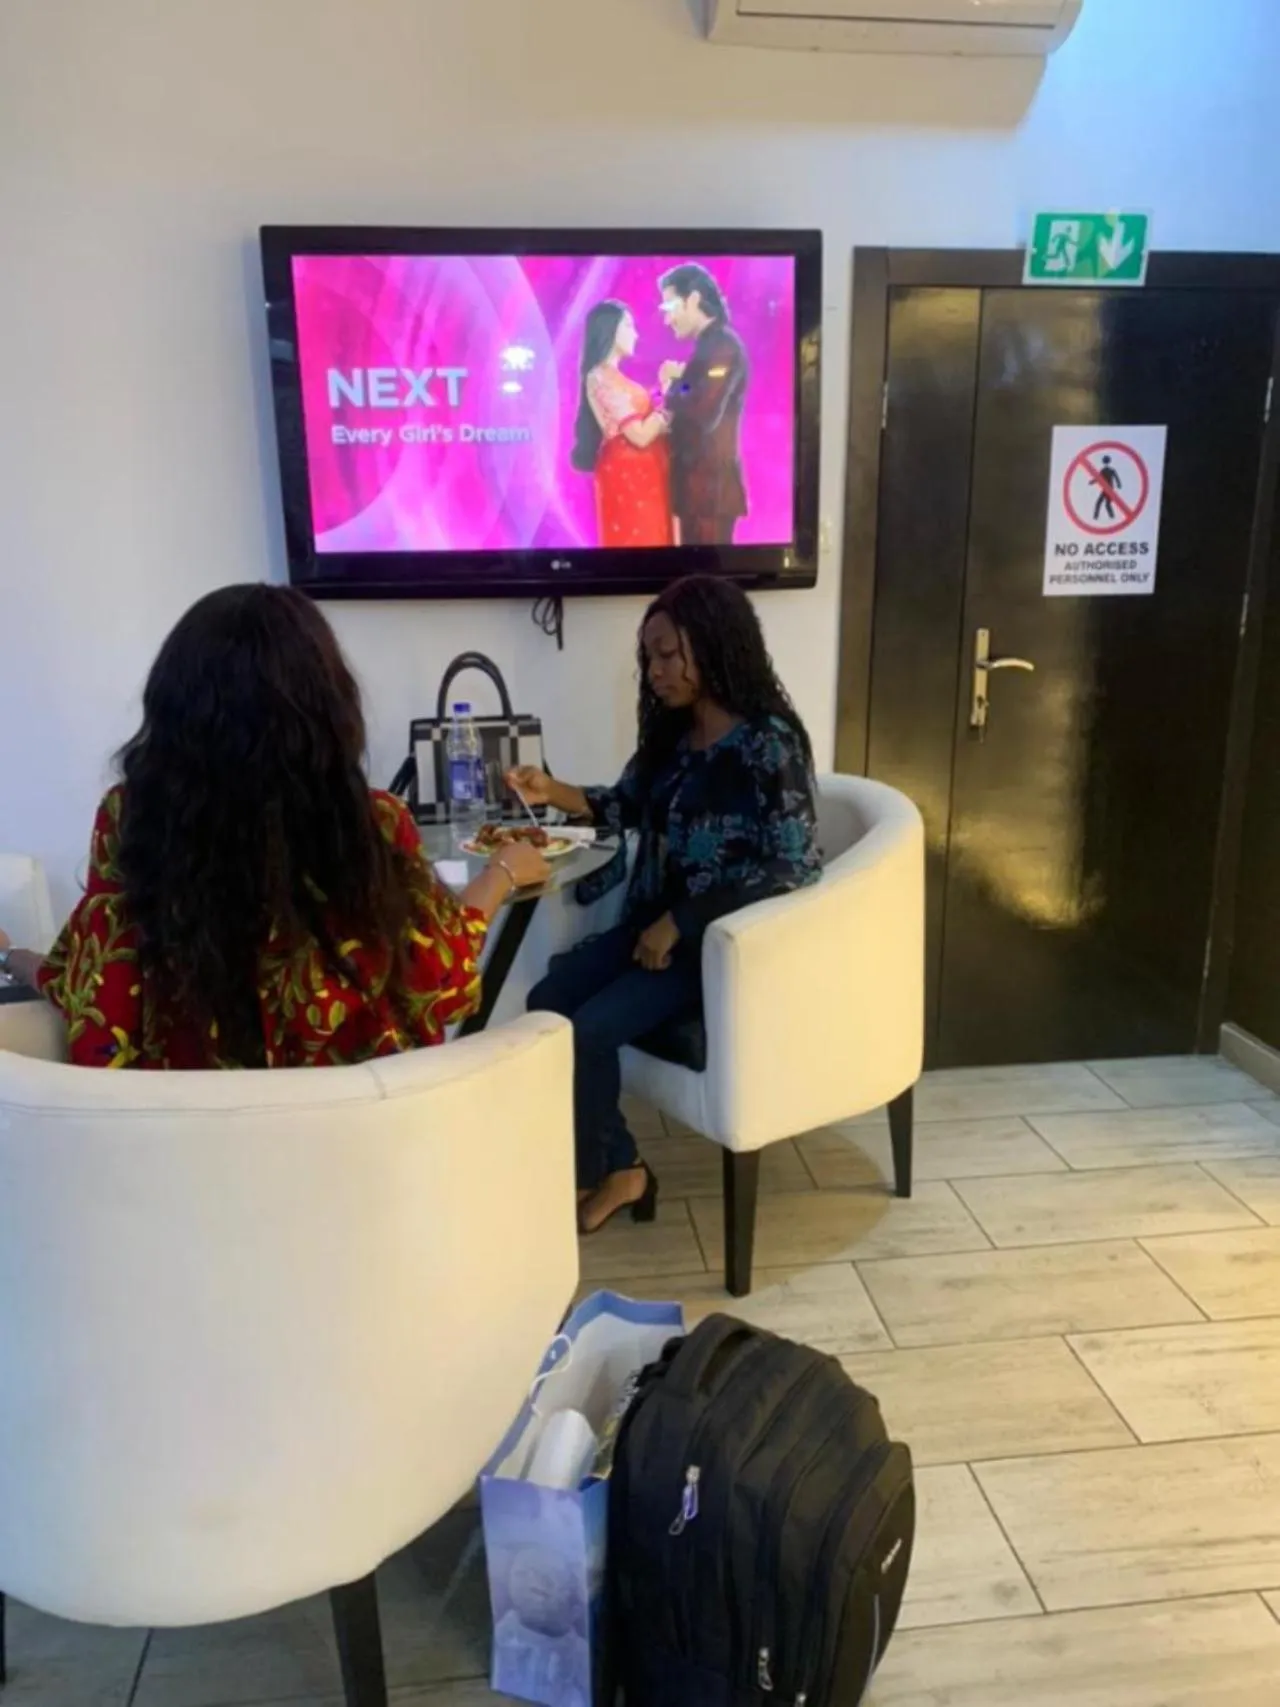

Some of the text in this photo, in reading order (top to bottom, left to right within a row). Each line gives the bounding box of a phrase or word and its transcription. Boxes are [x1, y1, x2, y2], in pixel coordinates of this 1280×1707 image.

[327, 367, 468, 408] NEXT
[331, 423, 531, 447] Every Girl's Dream
[1055, 542, 1149, 556] NO ACCESS
[1064, 560, 1138, 571] AUTHORISED
[1049, 573, 1150, 584] PERSONNEL ONLY
